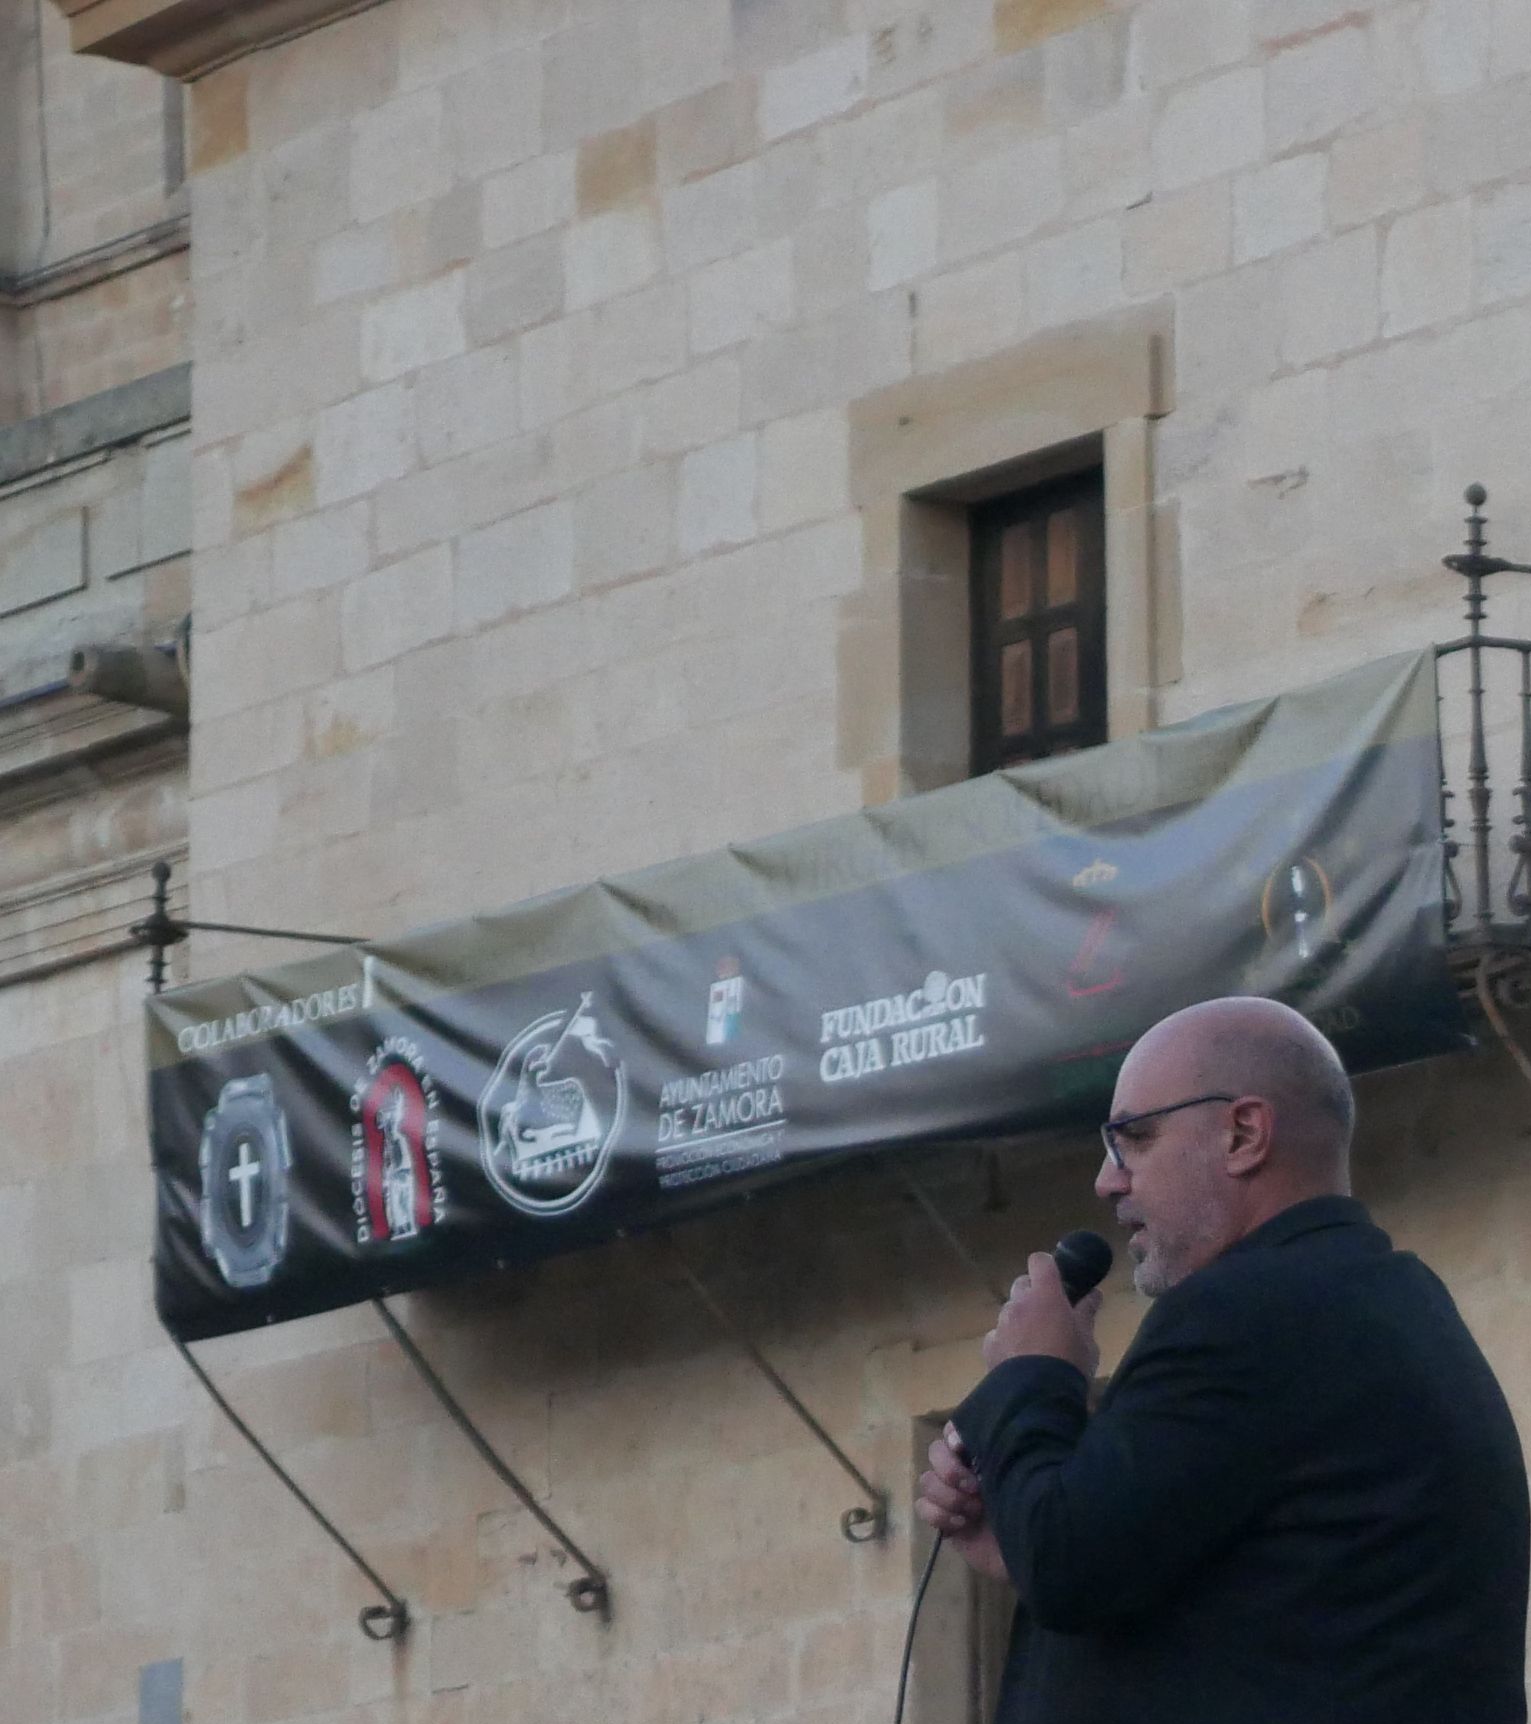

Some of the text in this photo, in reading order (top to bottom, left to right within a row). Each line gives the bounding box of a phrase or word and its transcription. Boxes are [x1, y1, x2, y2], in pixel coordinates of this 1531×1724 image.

[178, 983, 358, 1053] COLABORADORES
[820, 1015, 984, 1082] CAJA RURAL
[659, 1054, 784, 1107] AYUNTAMIENTO
[658, 1085, 783, 1142] DE ZAMORA
